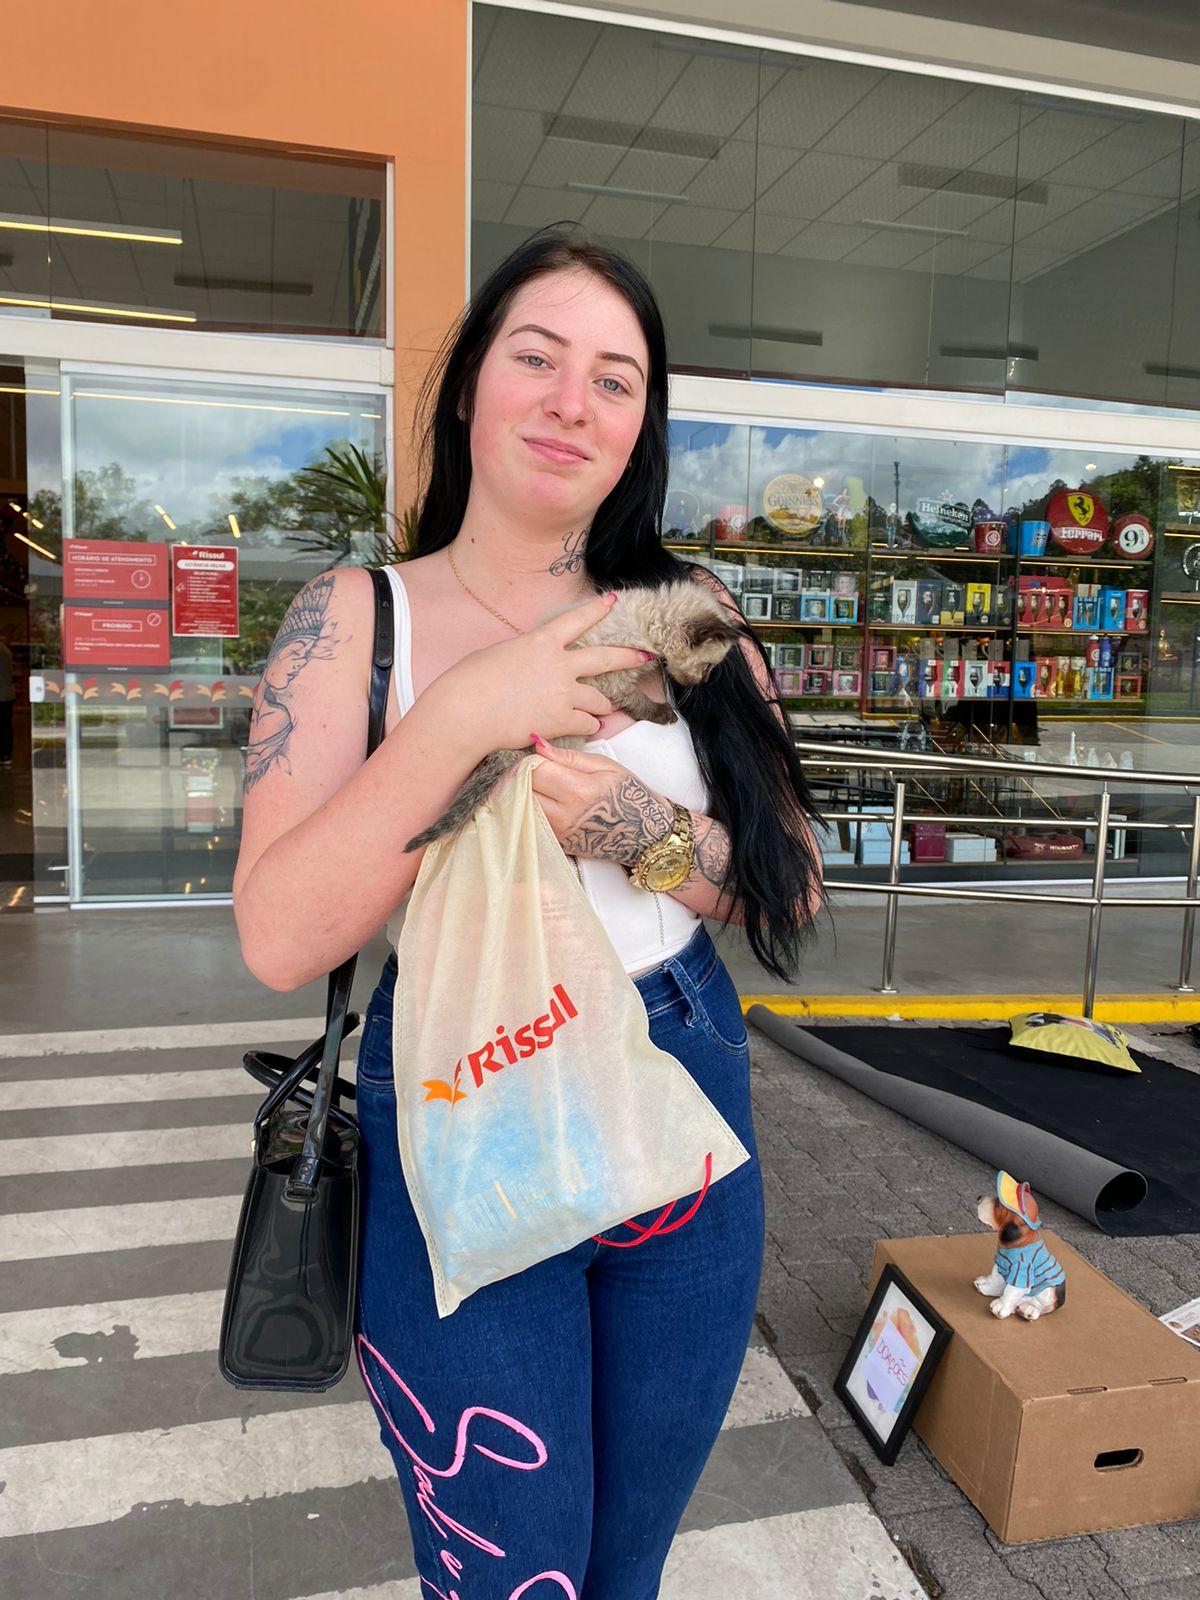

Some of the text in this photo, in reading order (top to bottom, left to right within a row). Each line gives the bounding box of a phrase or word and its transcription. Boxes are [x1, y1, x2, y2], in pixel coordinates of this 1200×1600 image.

[922, 503, 969, 521] Heineken
[1061, 526, 1103, 542] Ferrari
[71, 554, 100, 562] HORÁRIO
[199, 551, 225, 559] Rissul
